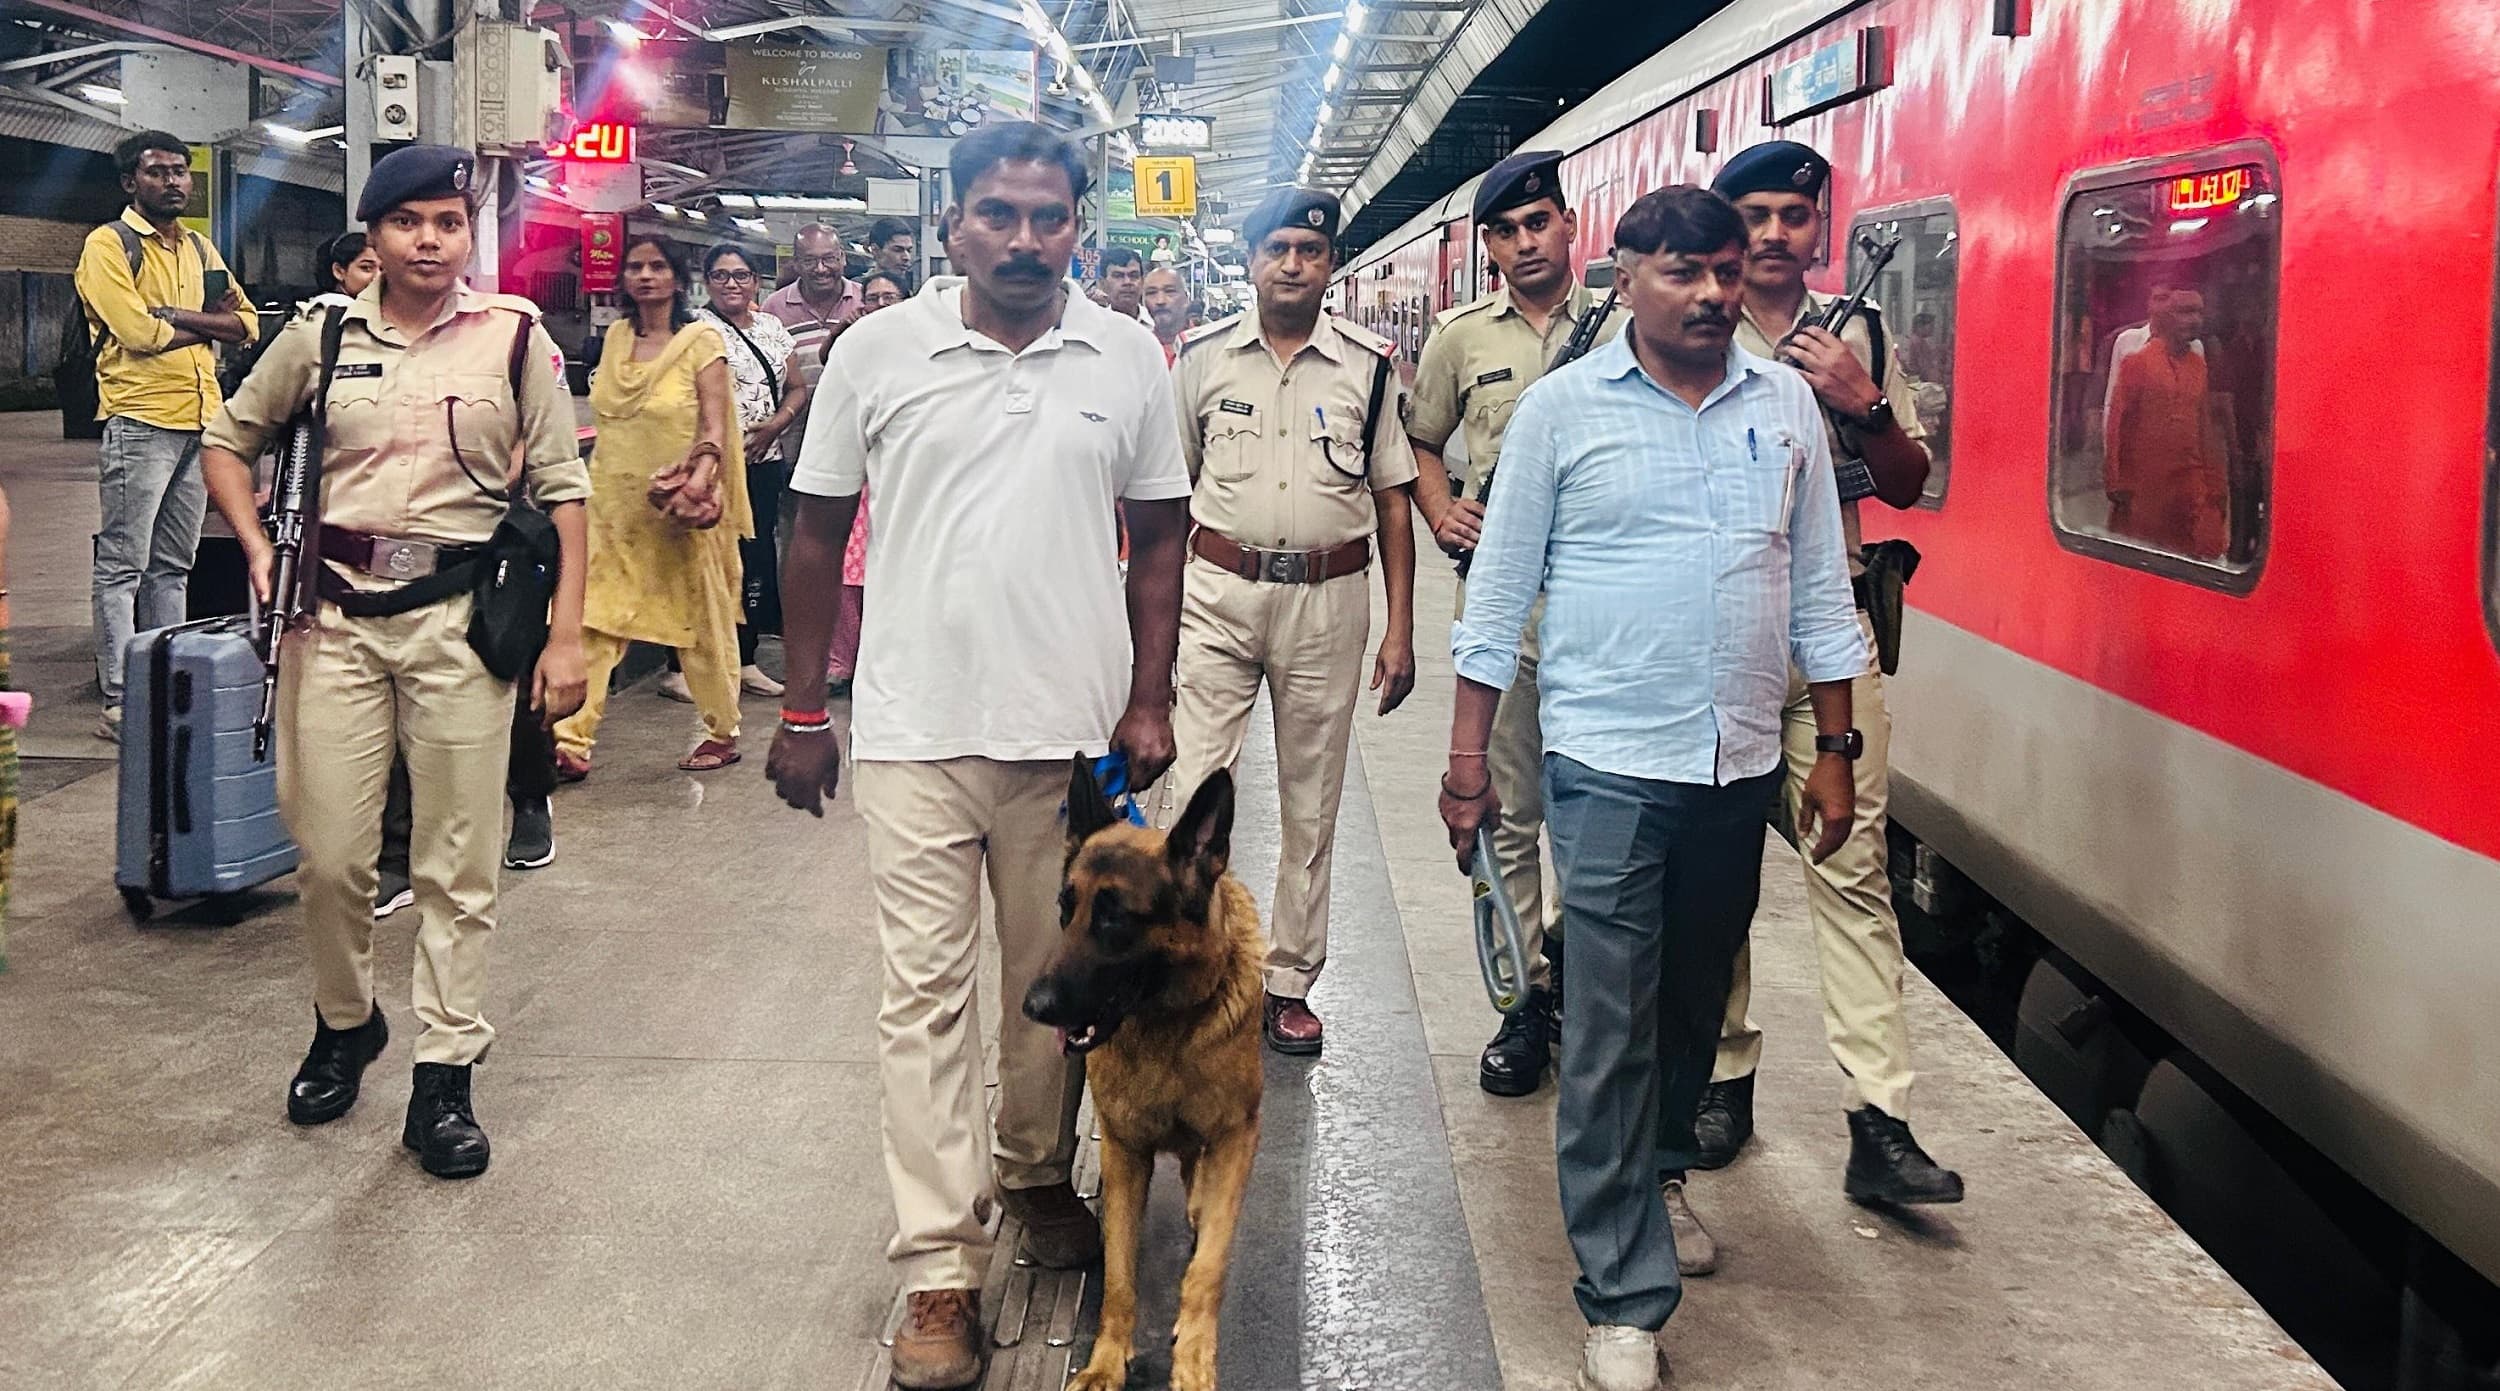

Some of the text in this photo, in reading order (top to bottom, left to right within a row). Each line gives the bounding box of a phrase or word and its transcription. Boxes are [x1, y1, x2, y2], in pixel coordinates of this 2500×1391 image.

[752, 48, 862, 61] WELCOME TO BOKARO
[761, 76, 853, 89] KUSHALPALLI
[1155, 170, 1172, 201] 1
[1118, 234, 1150, 246] SCHOOL
[1080, 264, 1097, 279] 26
